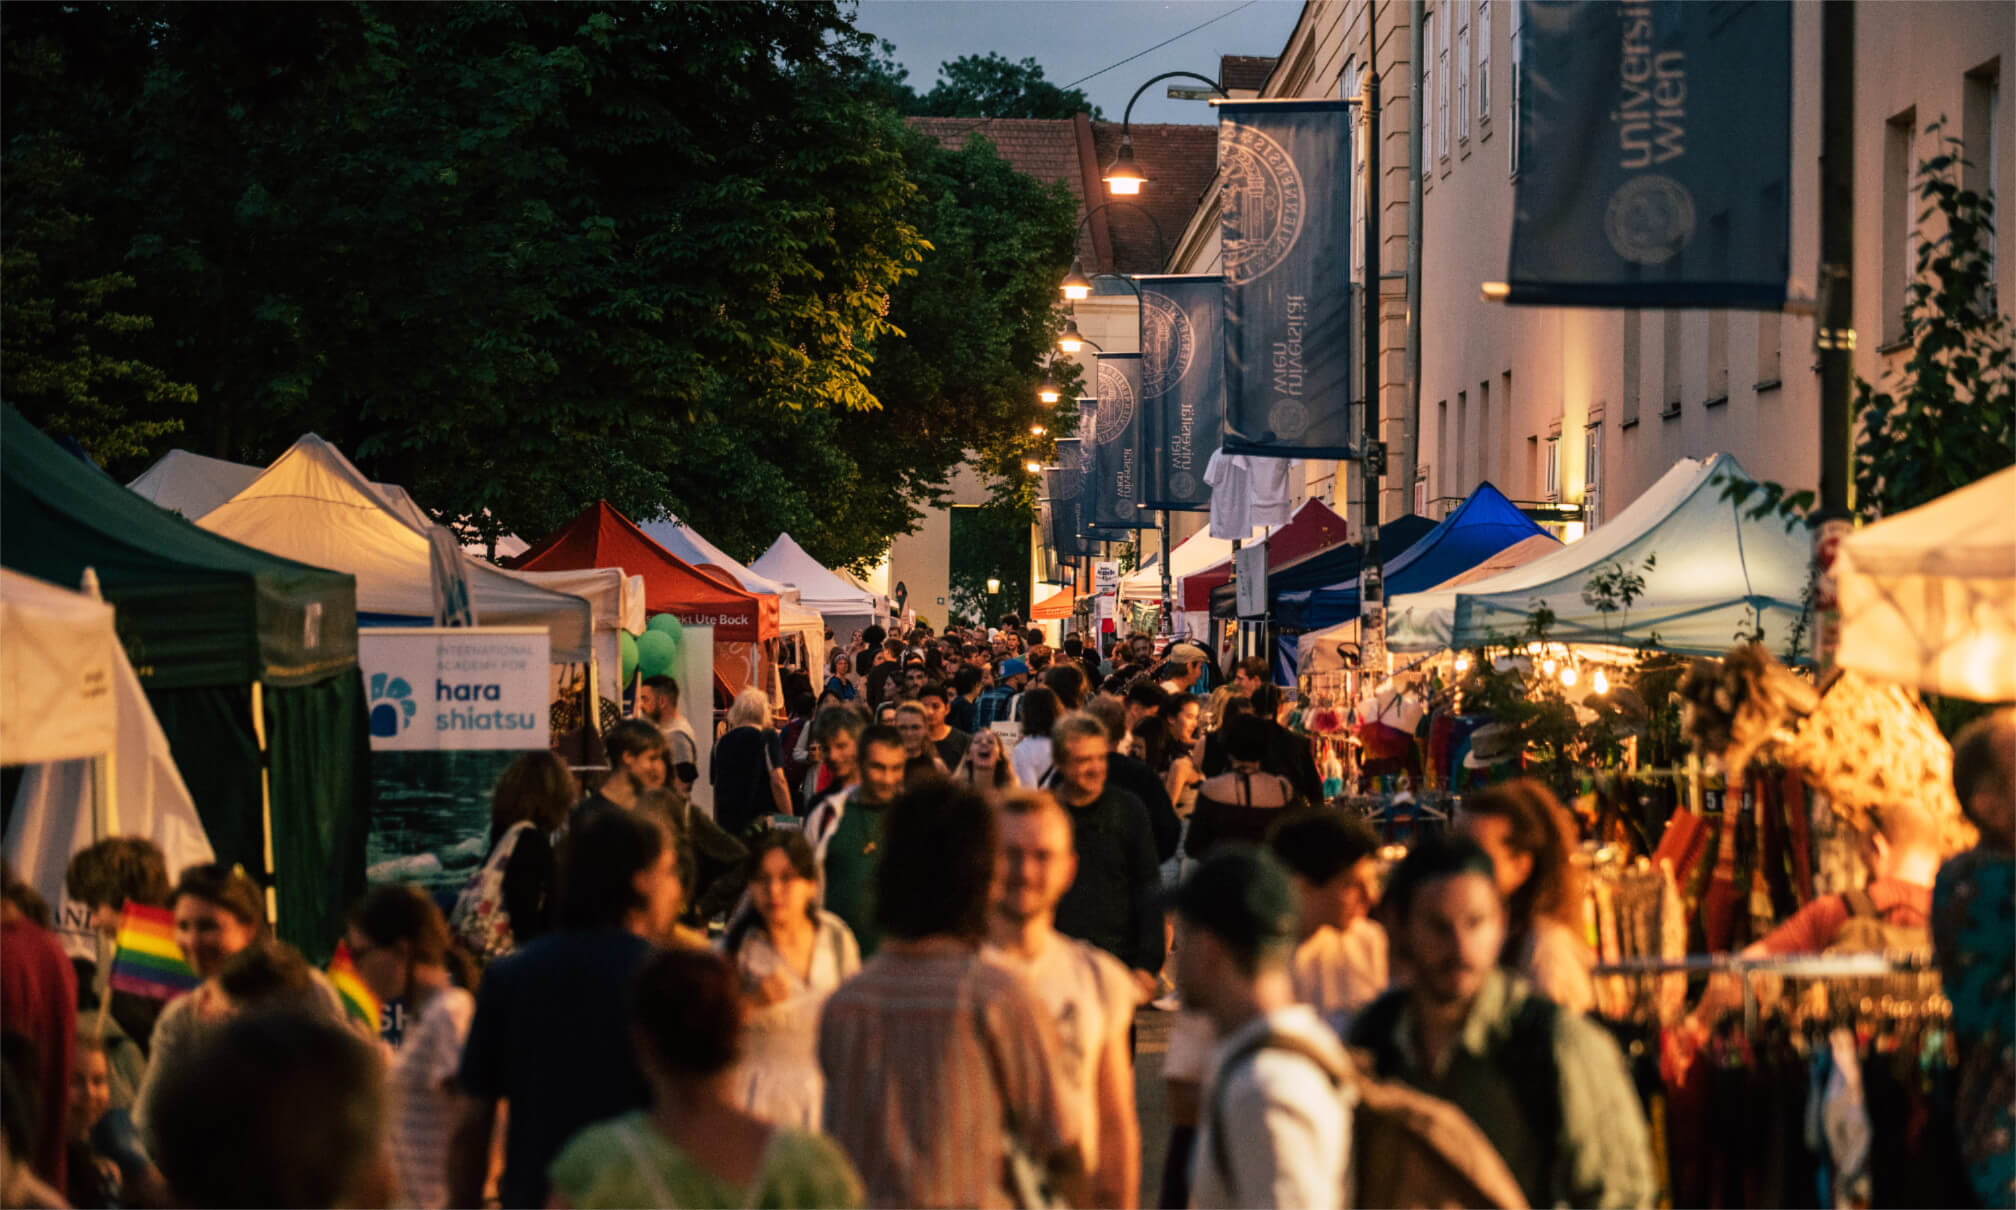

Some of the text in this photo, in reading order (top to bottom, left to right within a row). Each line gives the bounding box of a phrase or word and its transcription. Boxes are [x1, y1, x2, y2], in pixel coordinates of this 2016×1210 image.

[1611, 0, 1650, 168] universi
[1653, 51, 1686, 163] wien
[695, 614, 717, 625] Ute
[719, 614, 749, 625] Bock
[502, 660, 528, 671] FOR
[435, 678, 500, 701] hara
[435, 706, 535, 731] shiatsu
